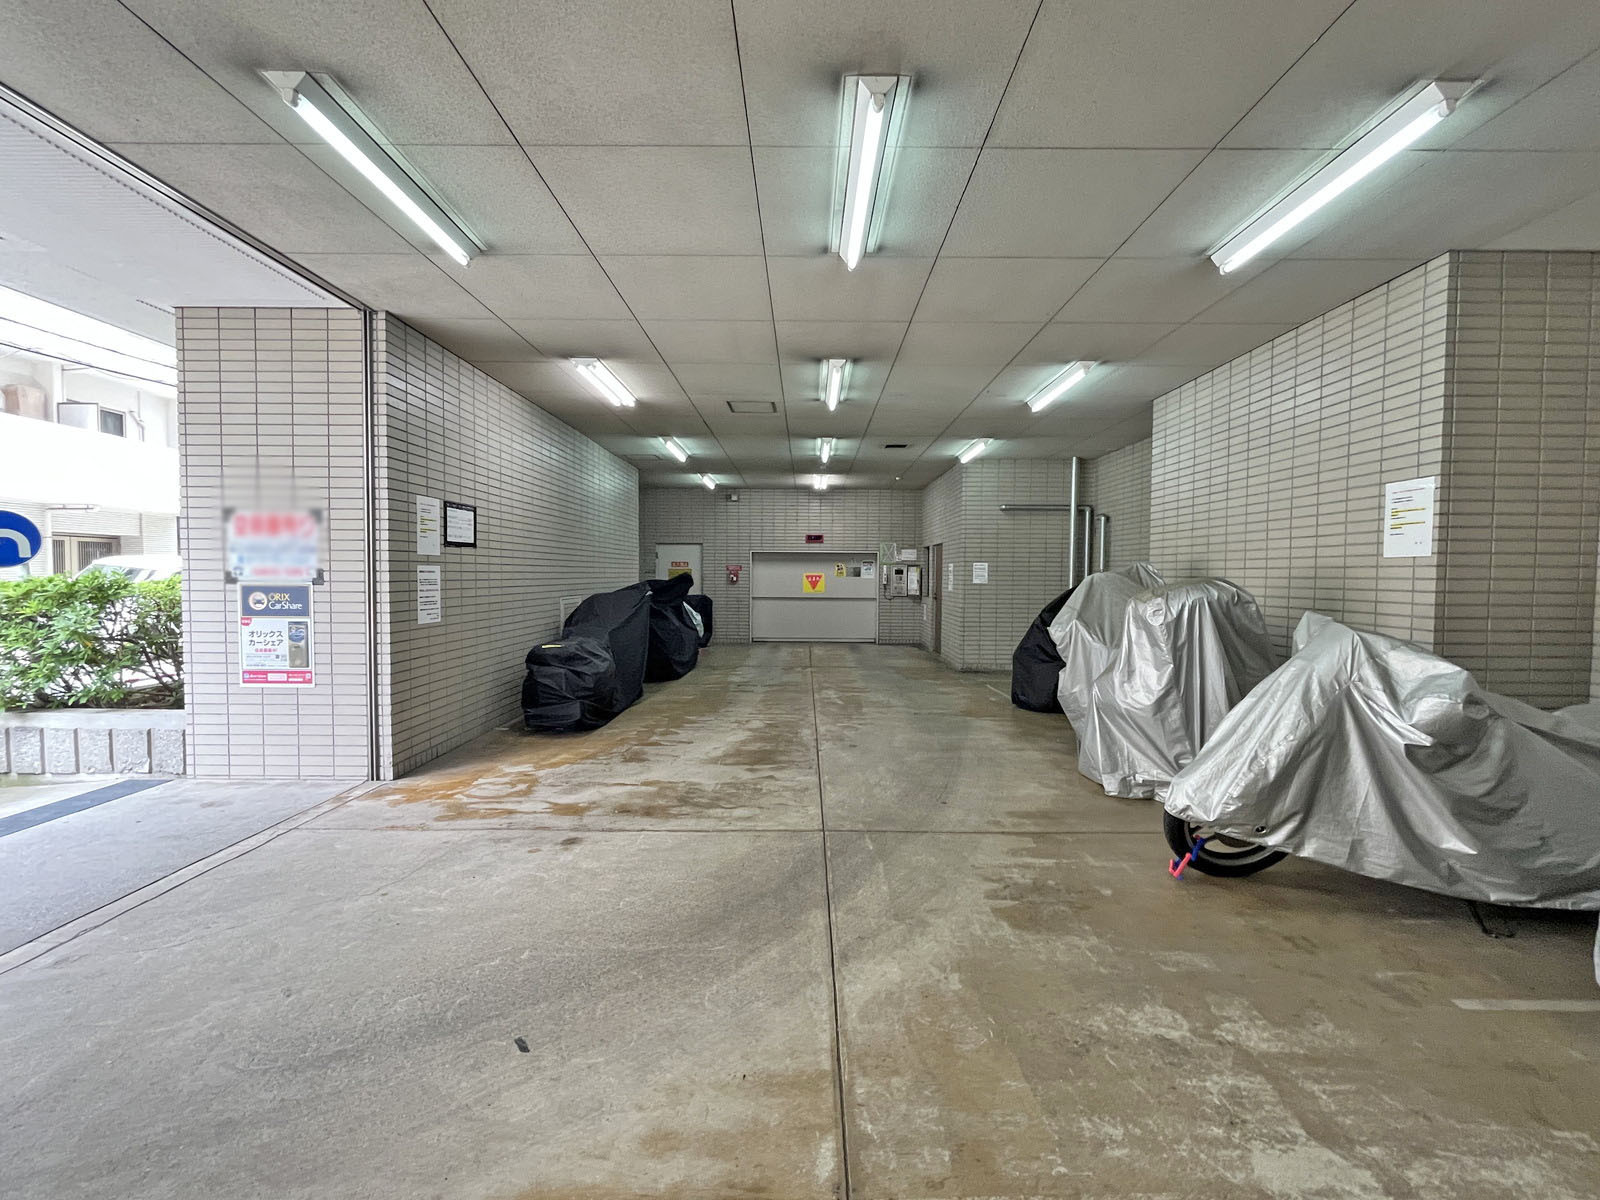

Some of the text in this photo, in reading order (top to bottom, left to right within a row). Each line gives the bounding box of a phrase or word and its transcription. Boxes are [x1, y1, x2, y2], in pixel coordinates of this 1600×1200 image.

[268, 593, 290, 601] ORIX
[248, 630, 284, 638] オリックス
[248, 639, 284, 647] カーシェア
